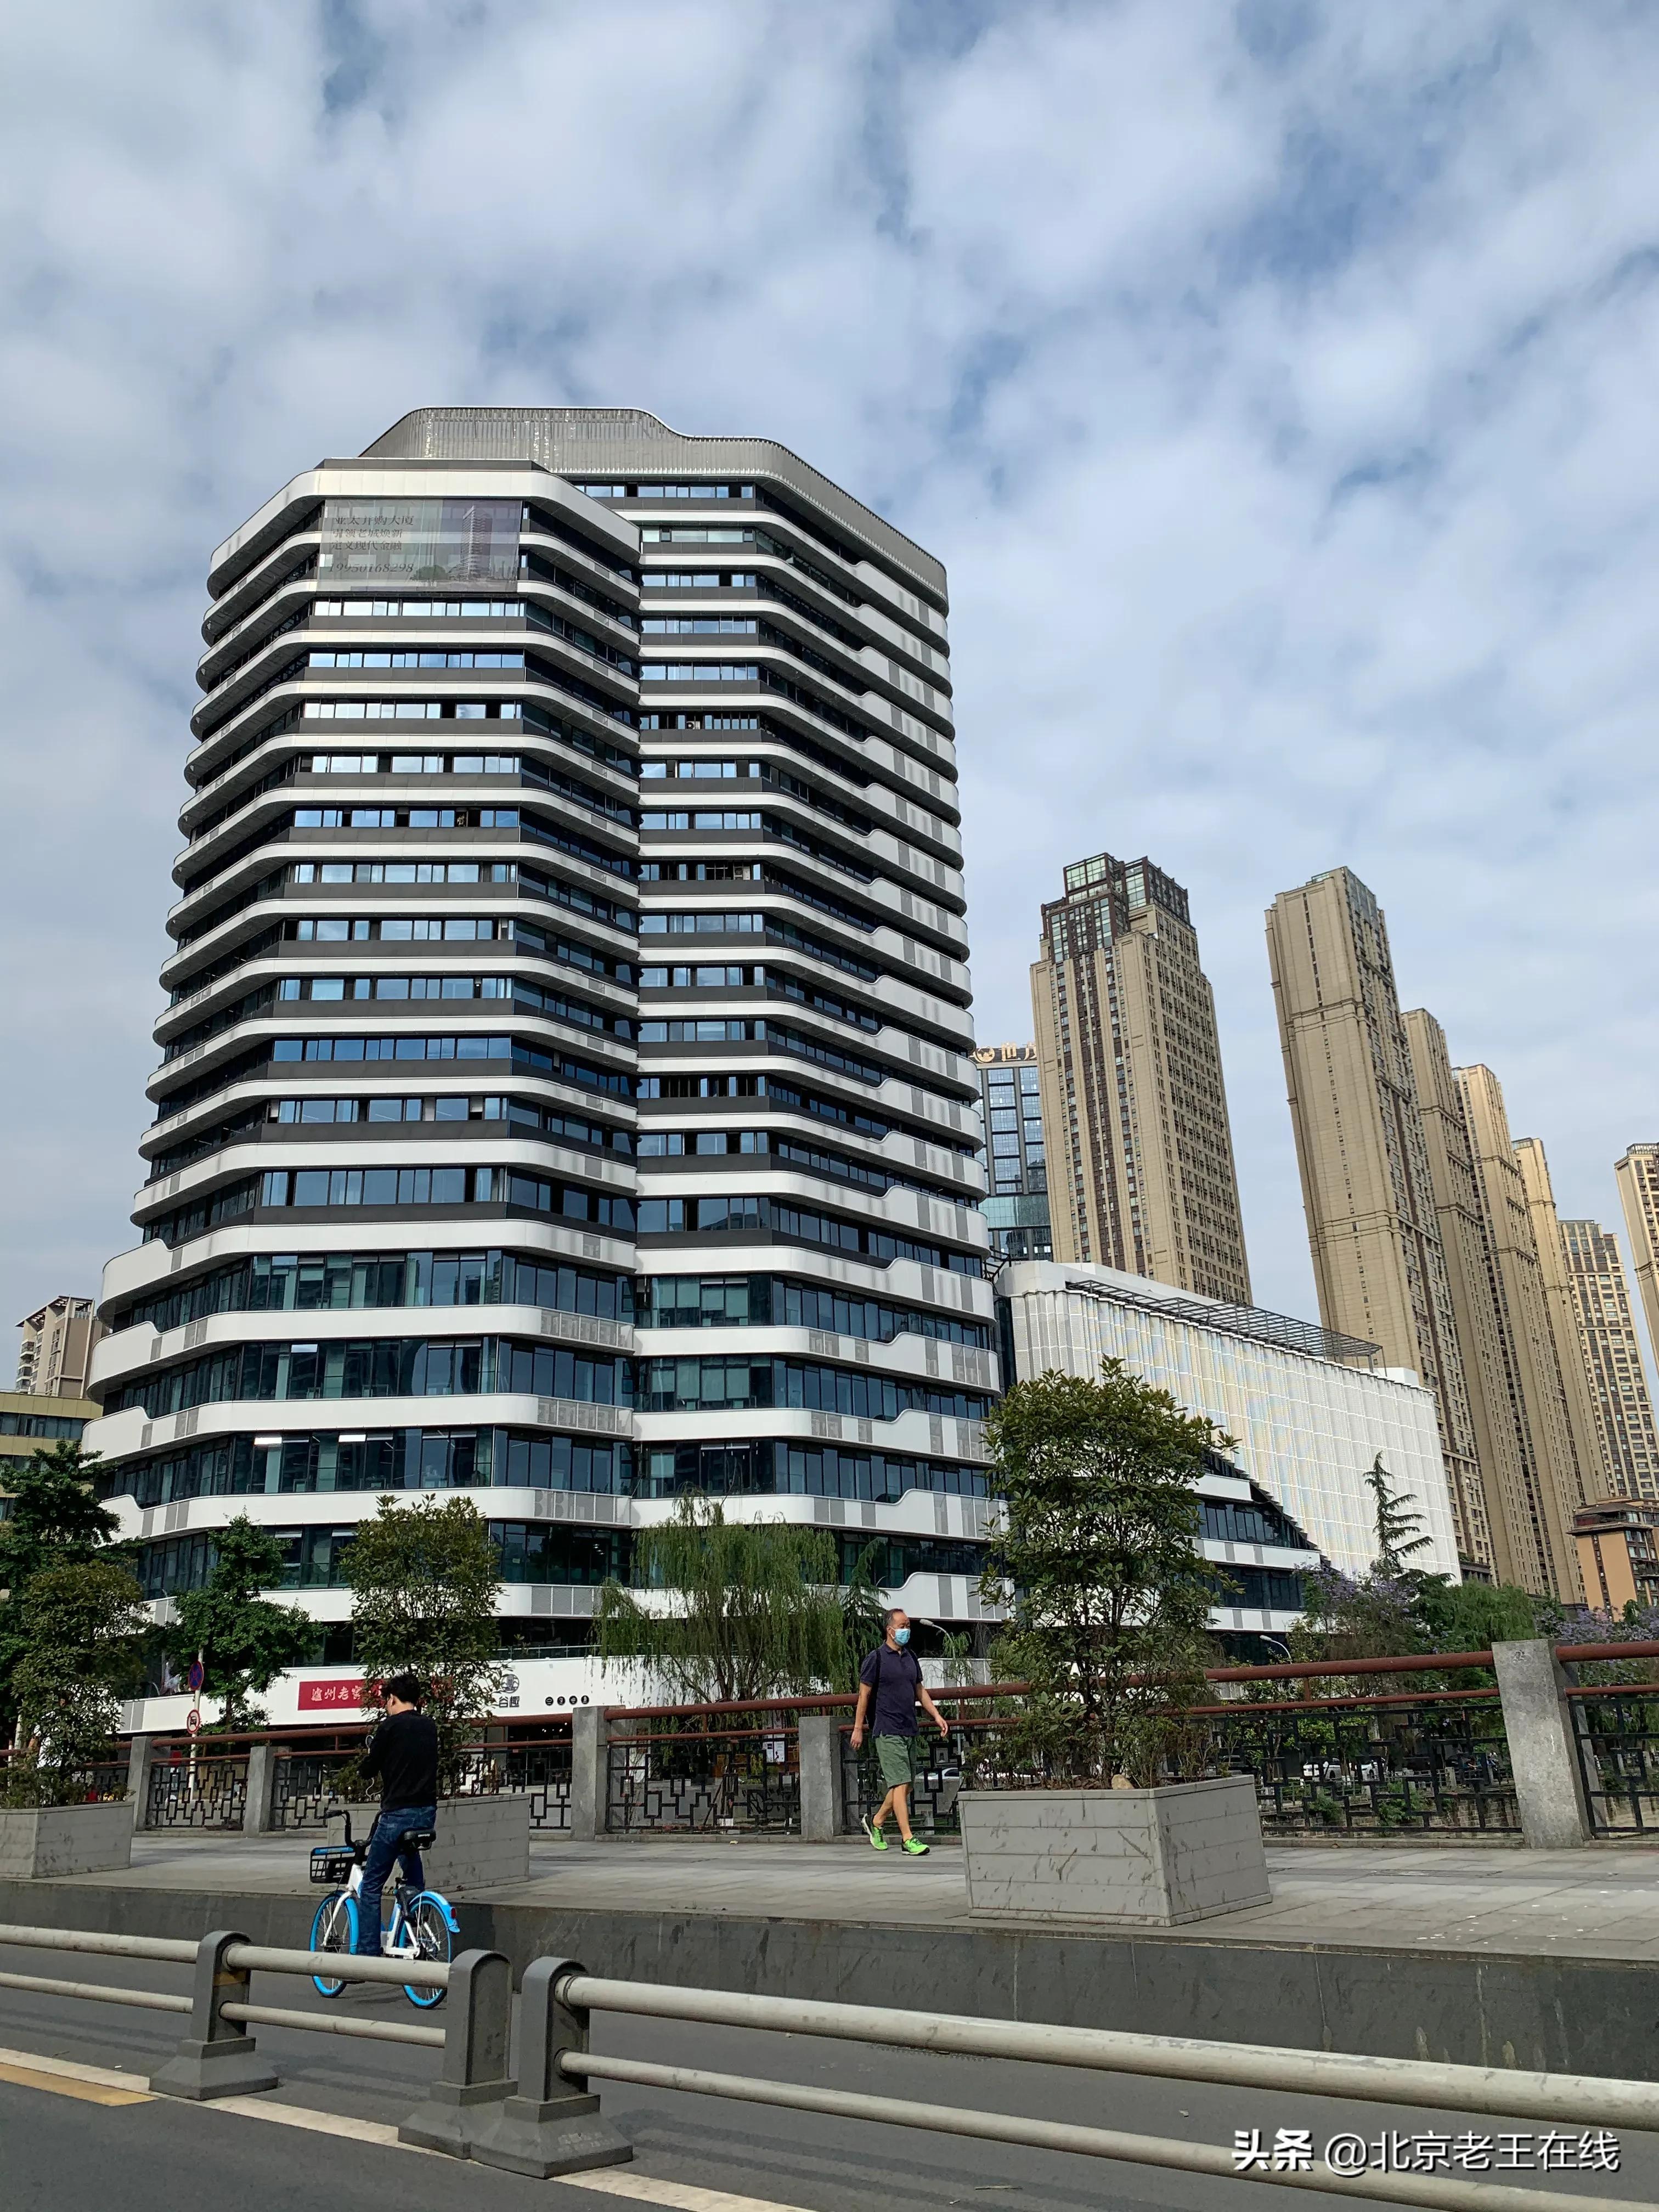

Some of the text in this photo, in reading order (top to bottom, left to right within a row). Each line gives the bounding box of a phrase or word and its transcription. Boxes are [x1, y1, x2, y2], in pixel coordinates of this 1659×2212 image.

[331, 540, 402, 550] 定义现代金融
